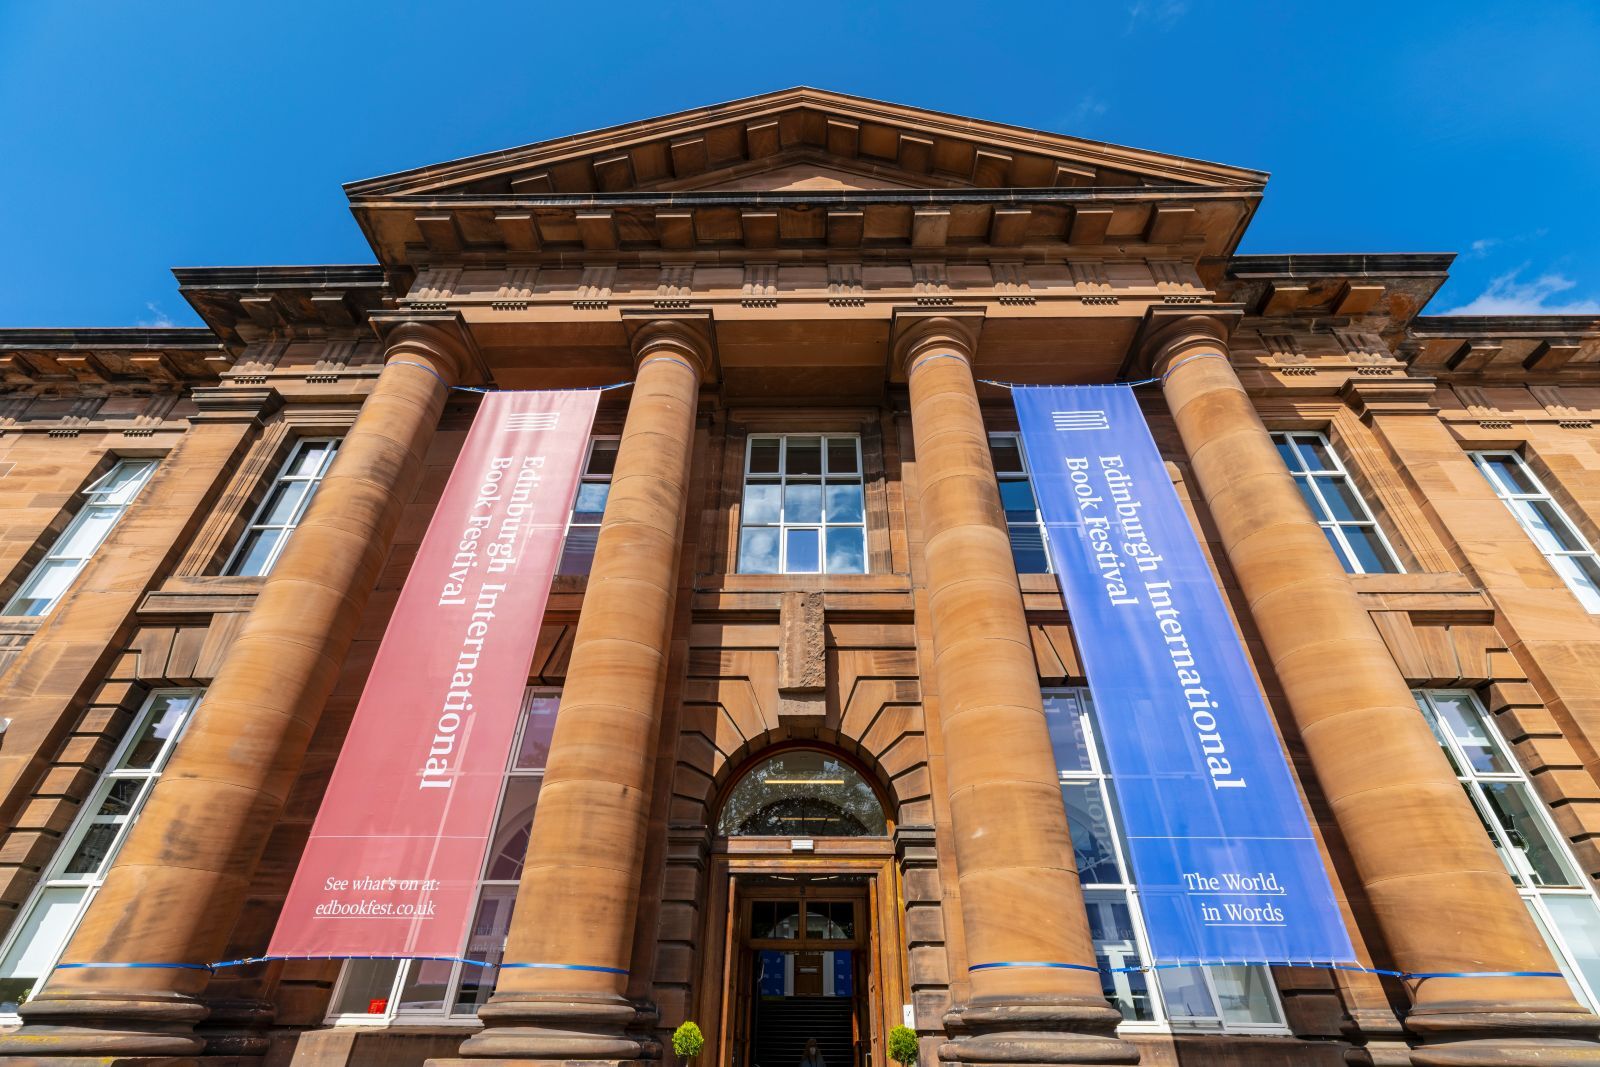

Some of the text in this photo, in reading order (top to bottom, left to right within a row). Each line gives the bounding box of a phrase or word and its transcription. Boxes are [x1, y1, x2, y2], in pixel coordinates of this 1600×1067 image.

[439, 455, 513, 606] Book Festival
[1065, 456, 1140, 607] Book Festival
[419, 455, 546, 790] Edinburgh International
[1098, 454, 1247, 790] Edinburgh International
[315, 900, 436, 915] edbookfest.co.uk
[324, 876, 441, 891] See what's on at:
[1183, 872, 1285, 894] The World,
[1201, 902, 1284, 921] in Words
